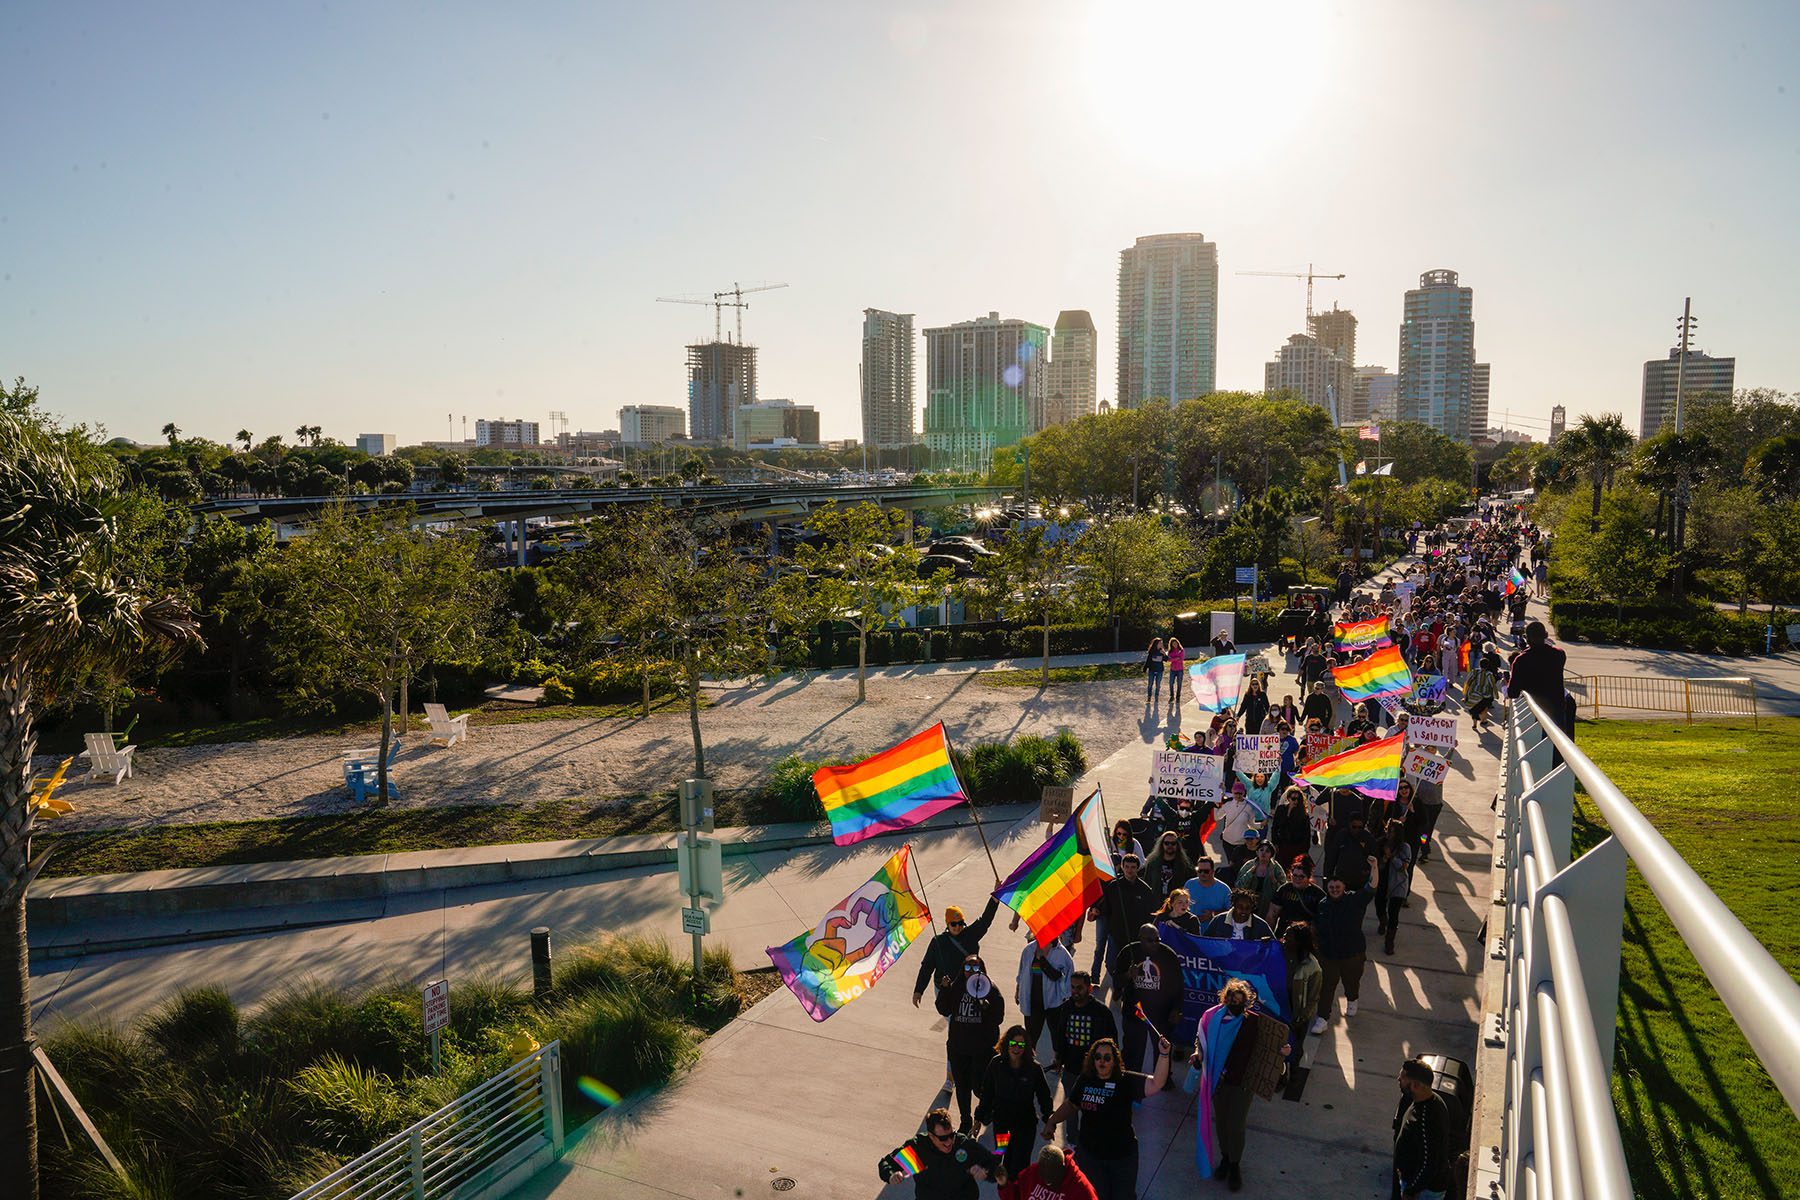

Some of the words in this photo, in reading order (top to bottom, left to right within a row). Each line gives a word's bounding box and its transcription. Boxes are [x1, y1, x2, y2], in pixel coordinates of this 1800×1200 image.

[1418, 688, 1443, 699] GAY
[1410, 717, 1426, 725] GAY
[1425, 719, 1440, 728] GAY
[1440, 719, 1454, 728] GAY
[1237, 736, 1259, 750] TEACH
[1421, 731, 1438, 741] SAID
[1441, 734, 1453, 744] IT!
[1159, 753, 1215, 767] HEATHER
[1259, 750, 1281, 759] RIGHTS
[1414, 755, 1435, 768] PROUD
[1435, 763, 1445, 771] TO
[1160, 764, 1204, 779] already
[1410, 763, 1425, 774] SAY
[1424, 768, 1442, 779] GAY
[1159, 777, 1178, 785] has
[1184, 777, 1201, 787] 2
[1158, 787, 1214, 797] MOMMIES
[432, 986, 441, 998] NO
[427, 1001, 446, 1013] PARKING
[427, 1012, 437, 1022] ANY
[437, 1008, 447, 1017] TIME
[437, 1017, 448, 1028] LANE
[1084, 1087, 1115, 1097] PROTECT
[1082, 1094, 1105, 1104] TRANS
